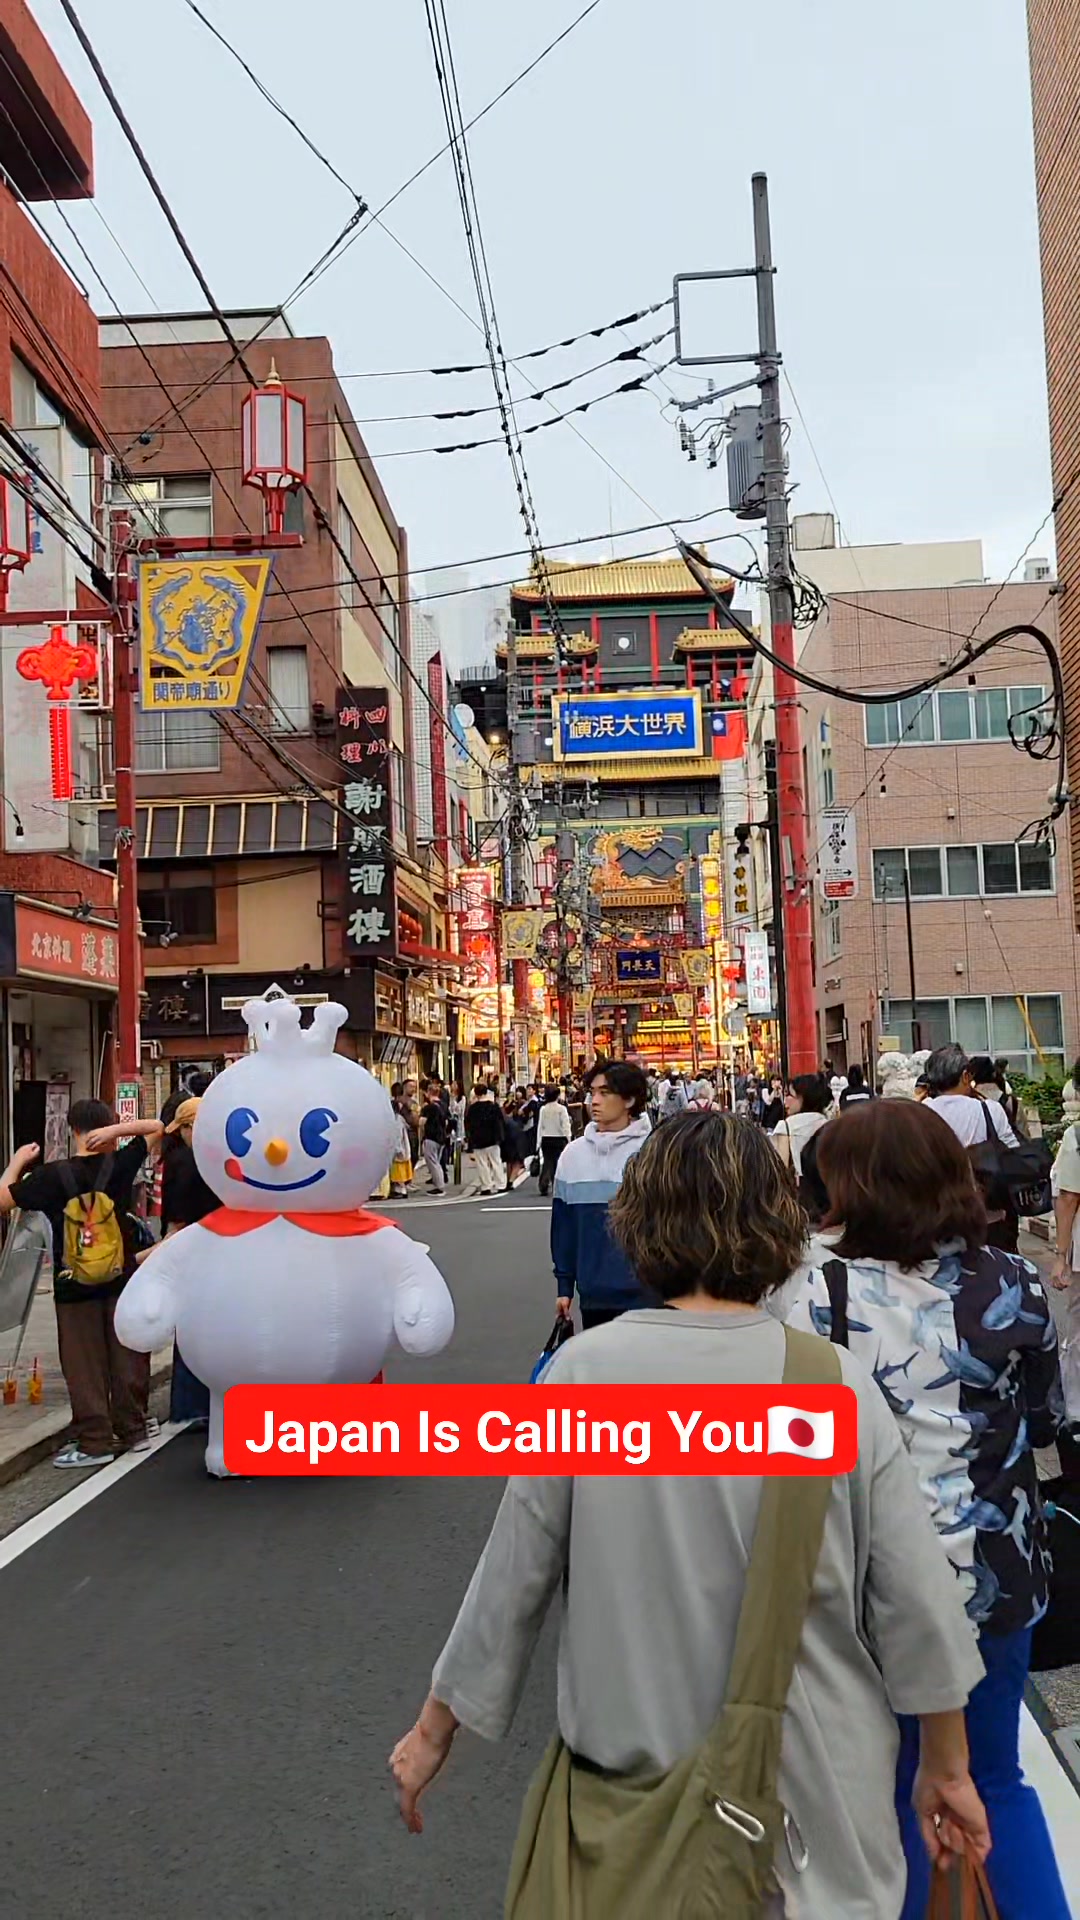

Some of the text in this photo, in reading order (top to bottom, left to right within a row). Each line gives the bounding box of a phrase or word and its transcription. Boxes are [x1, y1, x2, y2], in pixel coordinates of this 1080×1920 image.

[569, 712, 687, 739] 横浜大世界
